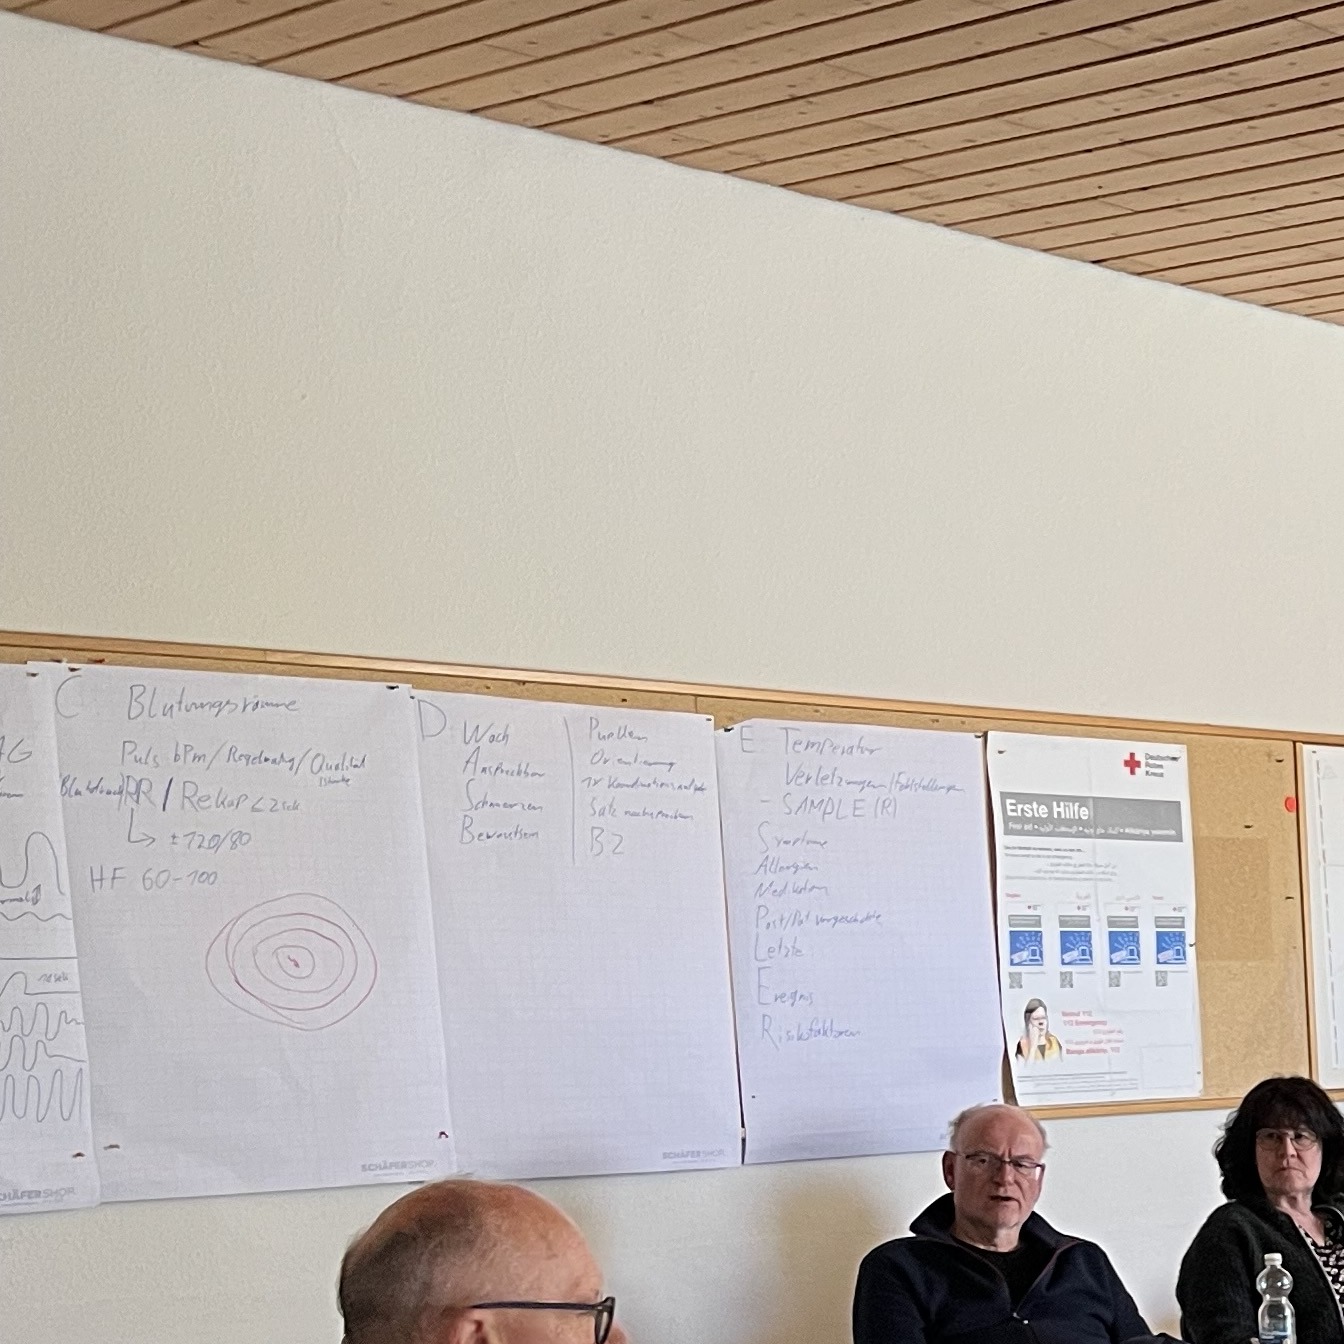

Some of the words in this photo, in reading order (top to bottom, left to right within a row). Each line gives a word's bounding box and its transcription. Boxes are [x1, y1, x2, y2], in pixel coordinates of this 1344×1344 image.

[417, 699, 447, 741] D
[120, 740, 160, 768] Puls
[740, 725, 753, 753] E
[779, 727, 883, 756] Temperatur
[783, 792, 866, 822] SAMPLE
[1005, 799, 1049, 818] Erste
[1053, 801, 1089, 819] Hilfe
[90, 866, 126, 893] HF
